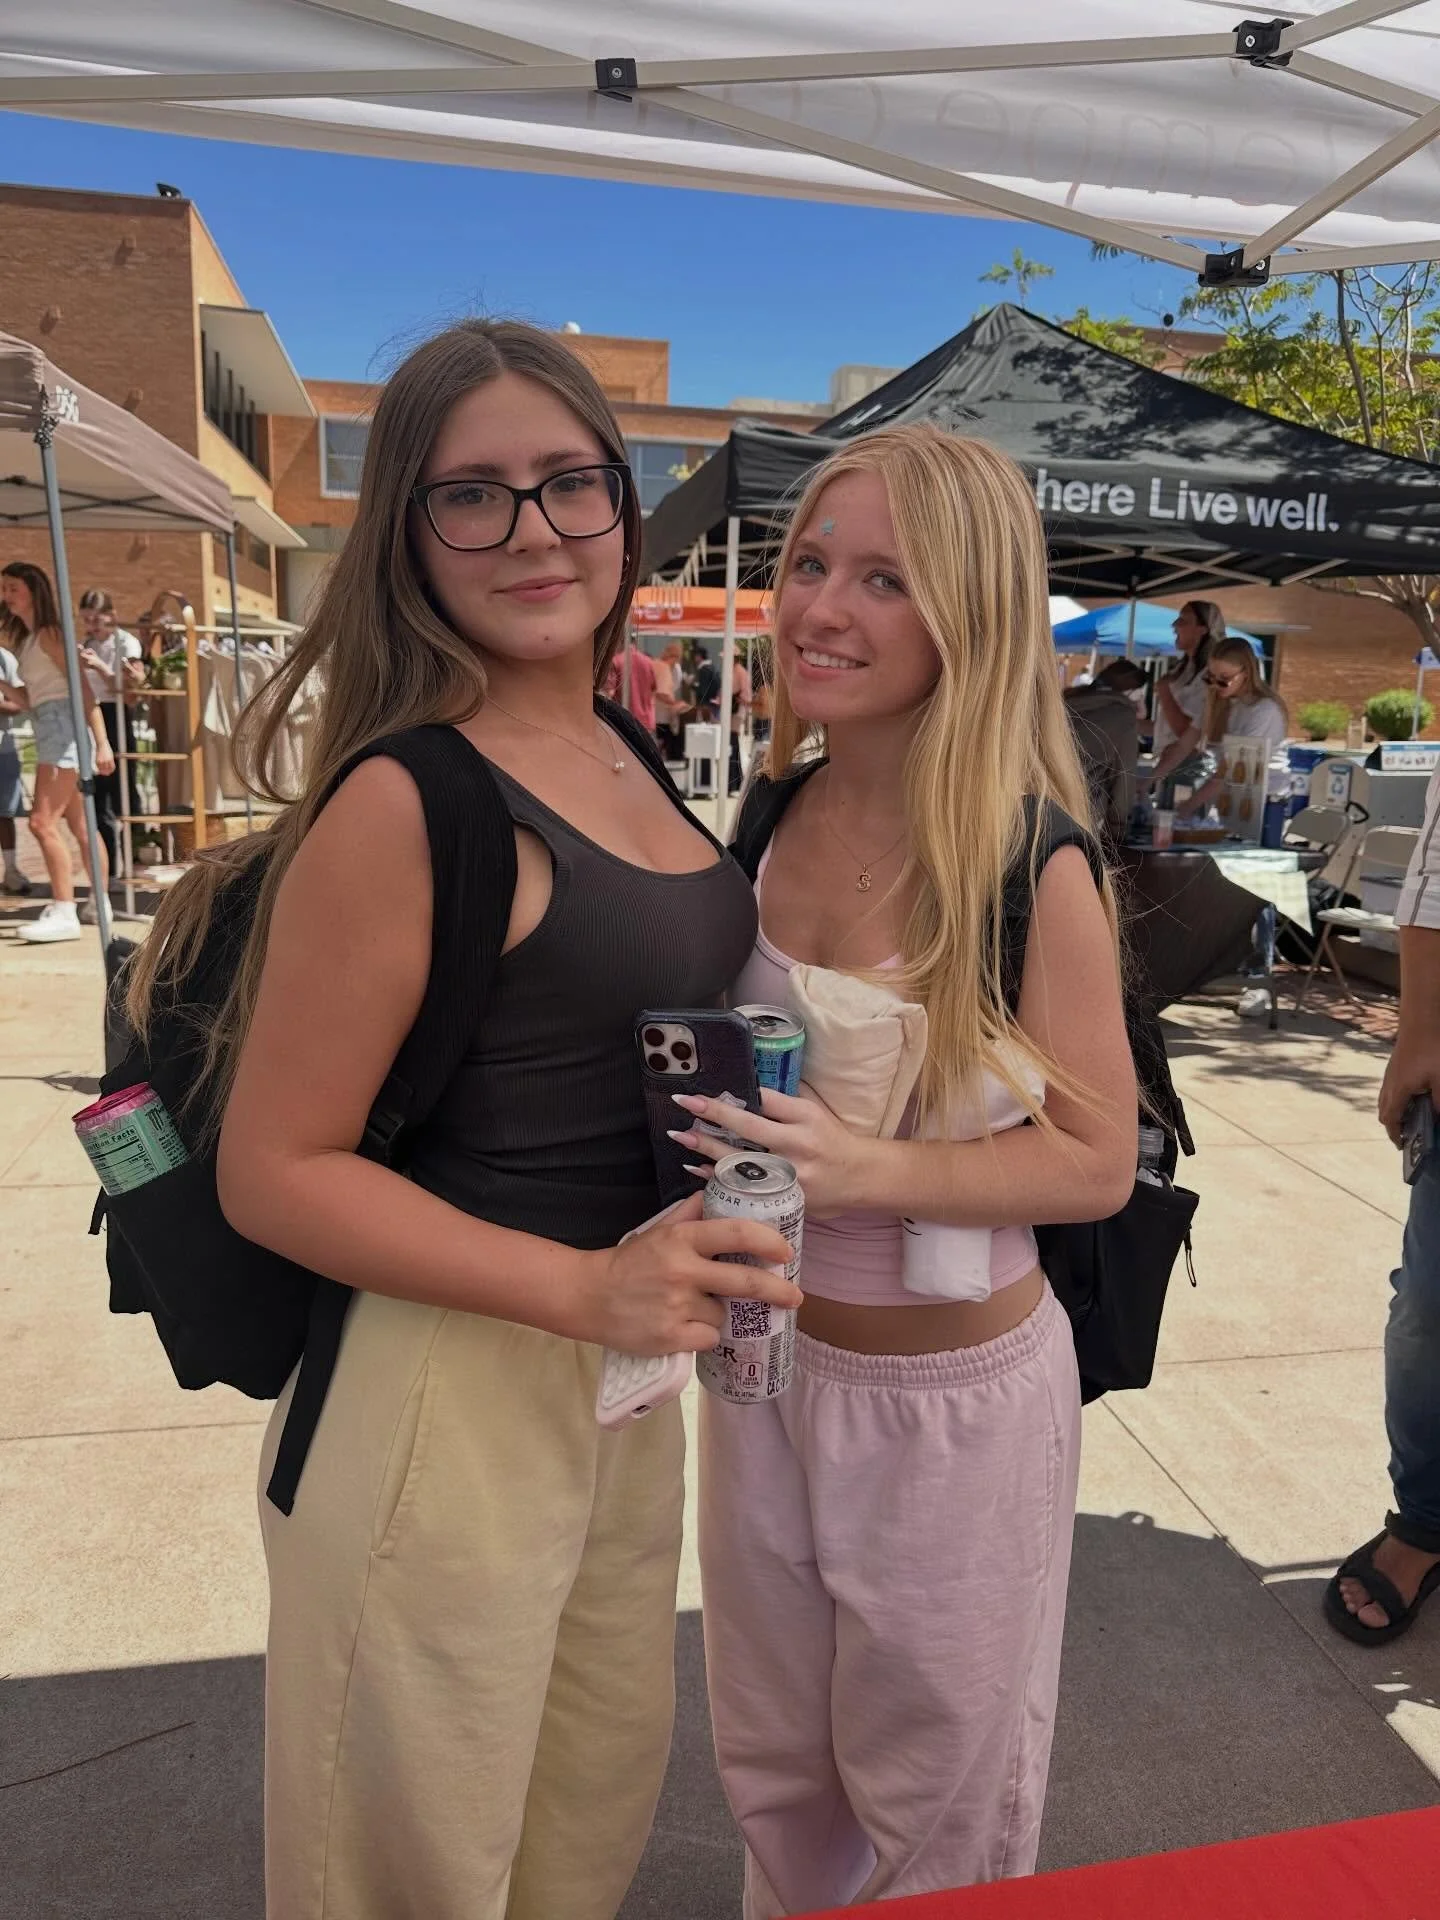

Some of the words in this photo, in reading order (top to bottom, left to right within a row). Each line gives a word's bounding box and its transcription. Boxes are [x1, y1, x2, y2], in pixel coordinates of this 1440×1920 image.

[1149, 477, 1238, 525] Live
[856, 873, 871, 892] S
[710, 1183, 741, 1207] SUGAR
[748, 1364, 756, 1377] 0
